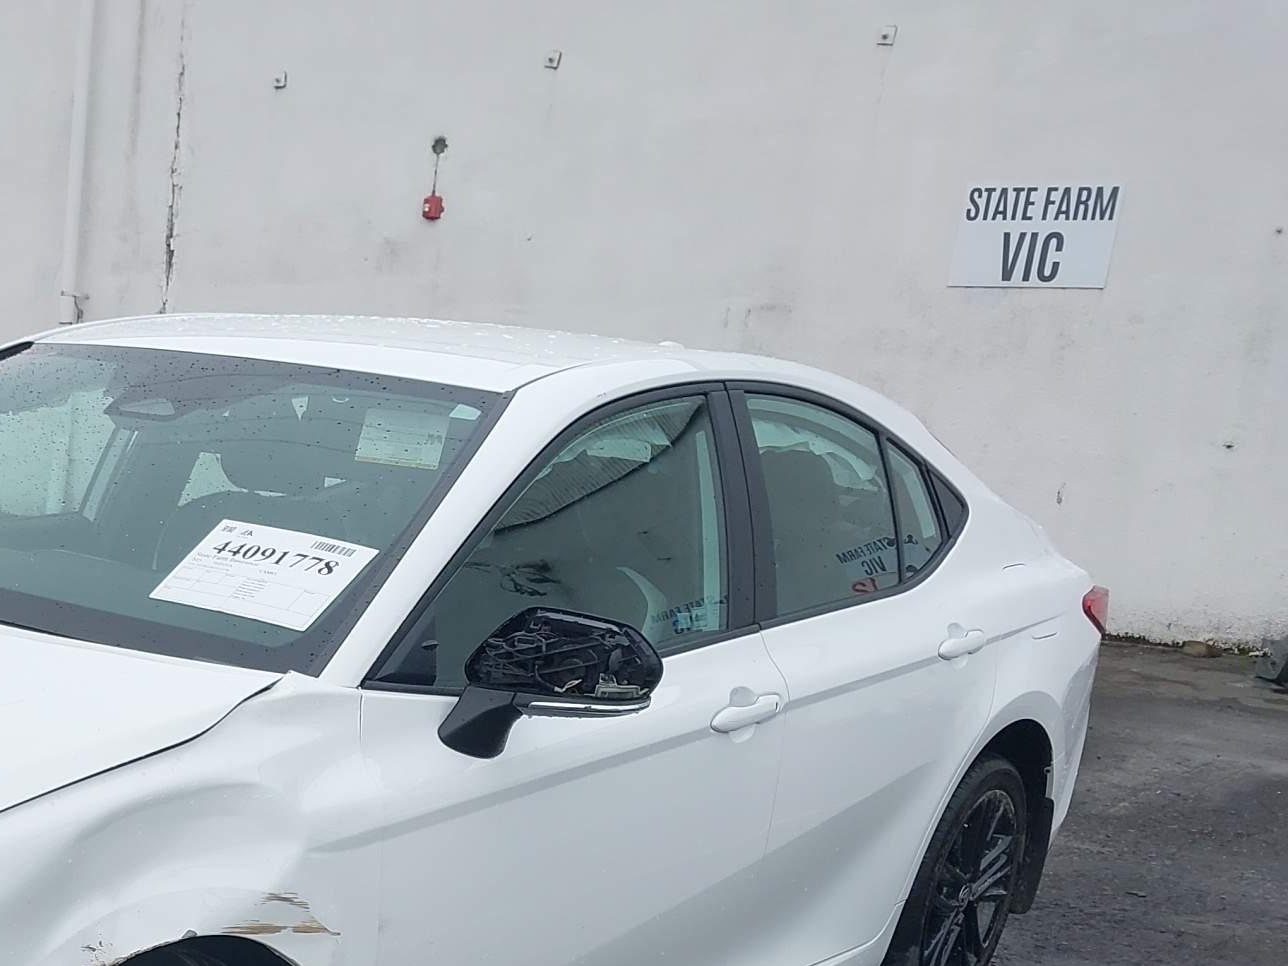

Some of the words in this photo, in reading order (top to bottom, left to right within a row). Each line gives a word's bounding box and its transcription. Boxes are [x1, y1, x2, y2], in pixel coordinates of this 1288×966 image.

[966, 187, 1038, 221] STATE
[1041, 186, 1120, 221] FARM
[1001, 231, 1064, 282] VIC
[213, 540, 339, 576] 44091778
